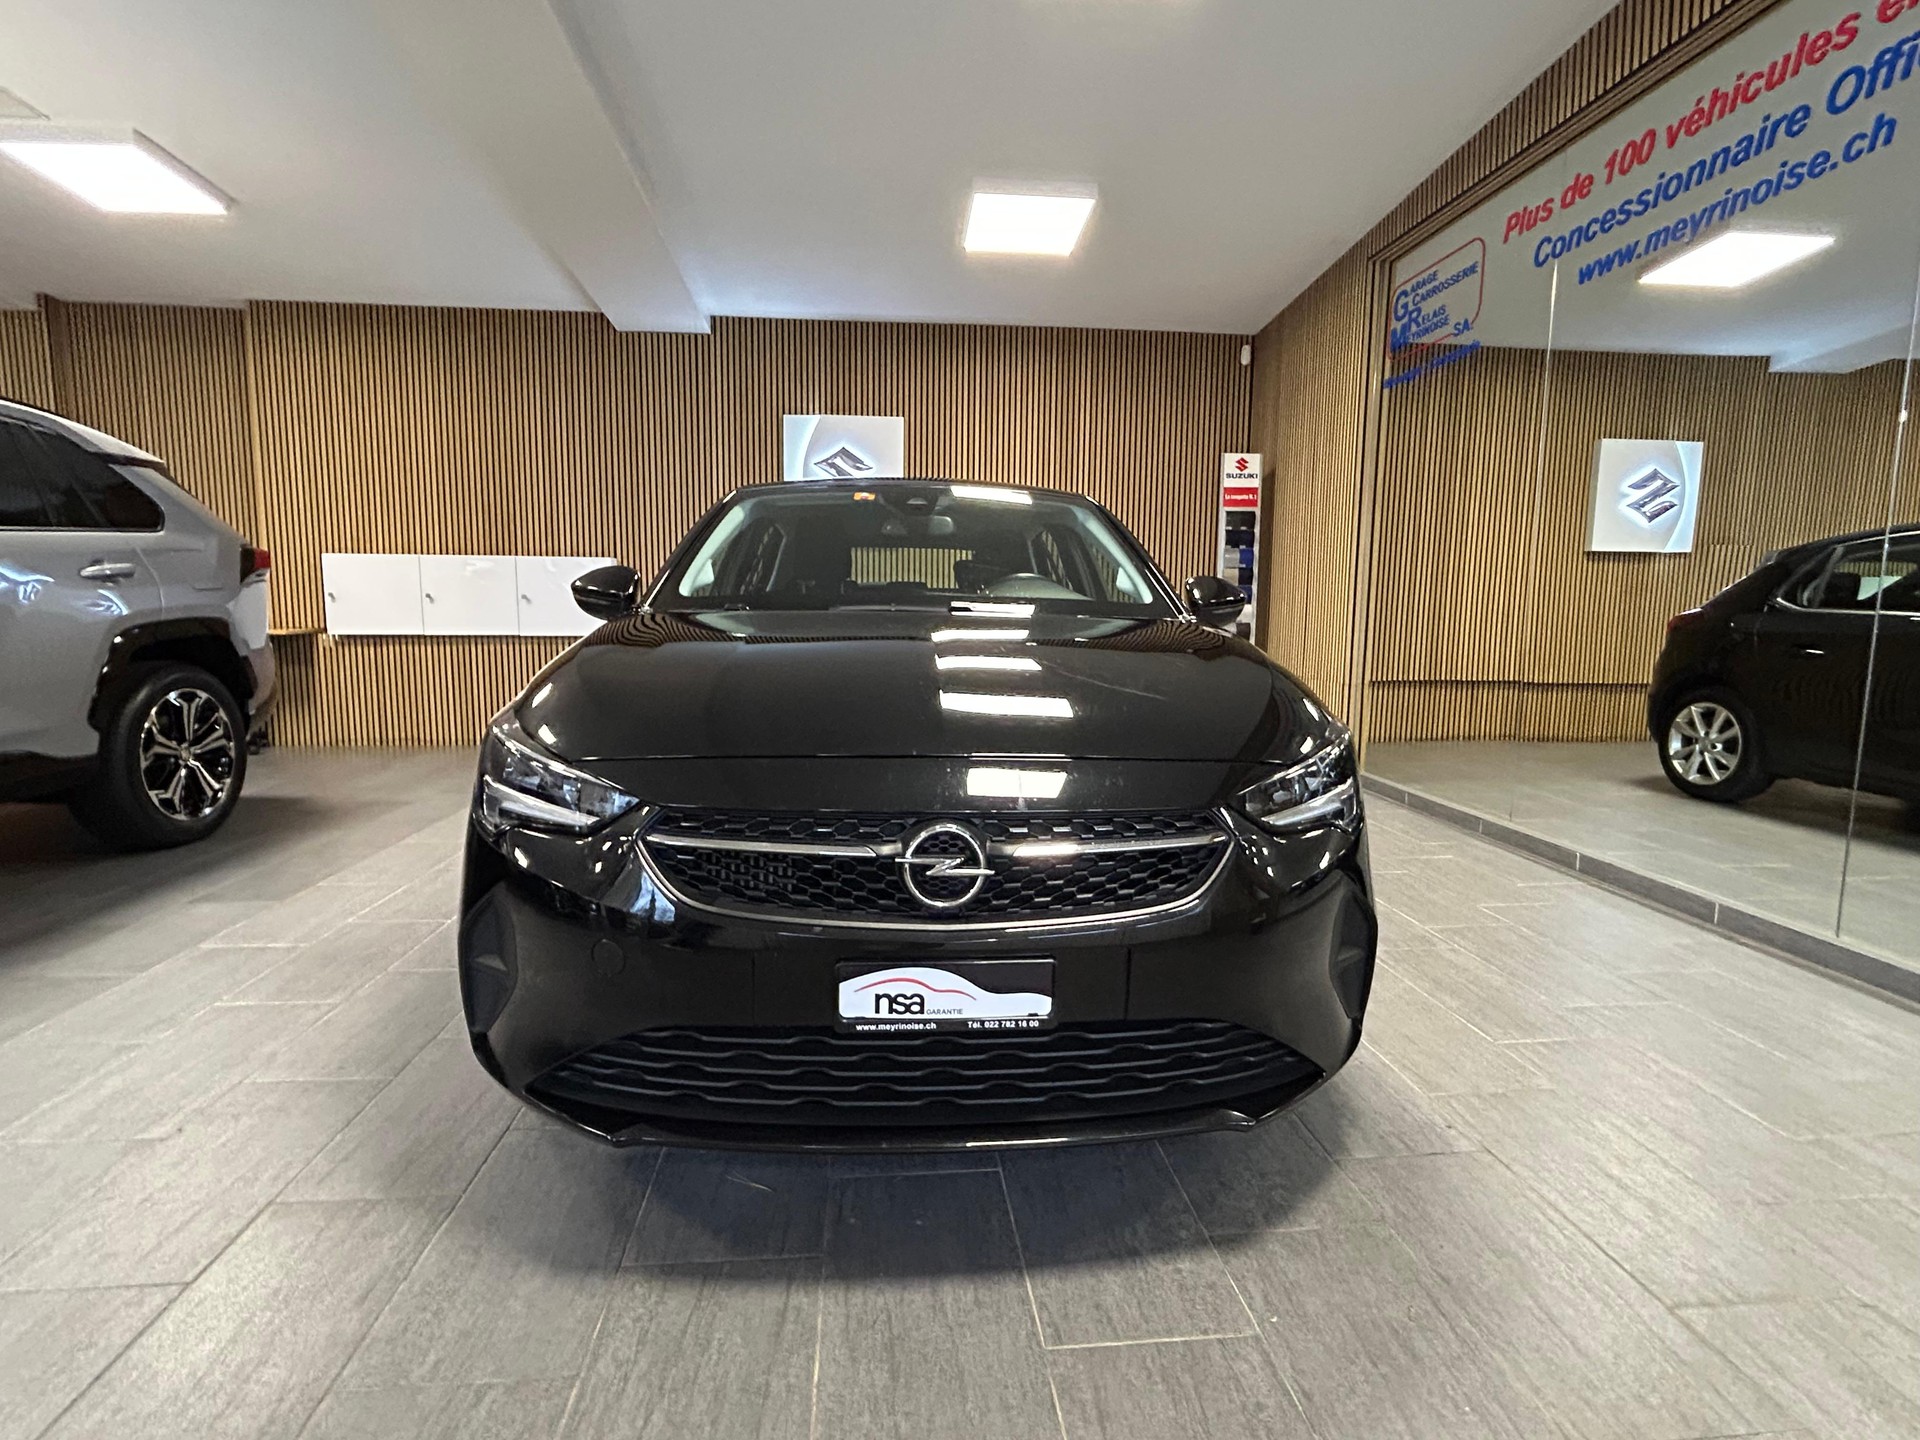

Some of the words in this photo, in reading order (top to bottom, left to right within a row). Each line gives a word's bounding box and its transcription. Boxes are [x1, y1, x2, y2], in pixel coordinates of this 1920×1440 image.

[1503, 197, 1555, 244] Plus
[1560, 172, 1595, 210] de
[1604, 128, 1657, 185] 100
[1666, 12, 1861, 149] véhicules
[1534, 104, 1812, 268] Concessionnaire
[1826, 30, 1920, 116] Offi
[1578, 113, 1898, 285] www.meyrinoise.ch
[1412, 260, 1479, 307] CARROSSERIE
[855, 1021, 937, 1032] www.meyrinoise.ch
[874, 993, 925, 1015] nsa
[984, 1020, 1000, 1029] 022
[1001, 1020, 1016, 1028] 782
[1028, 1019, 1040, 1028] 00
